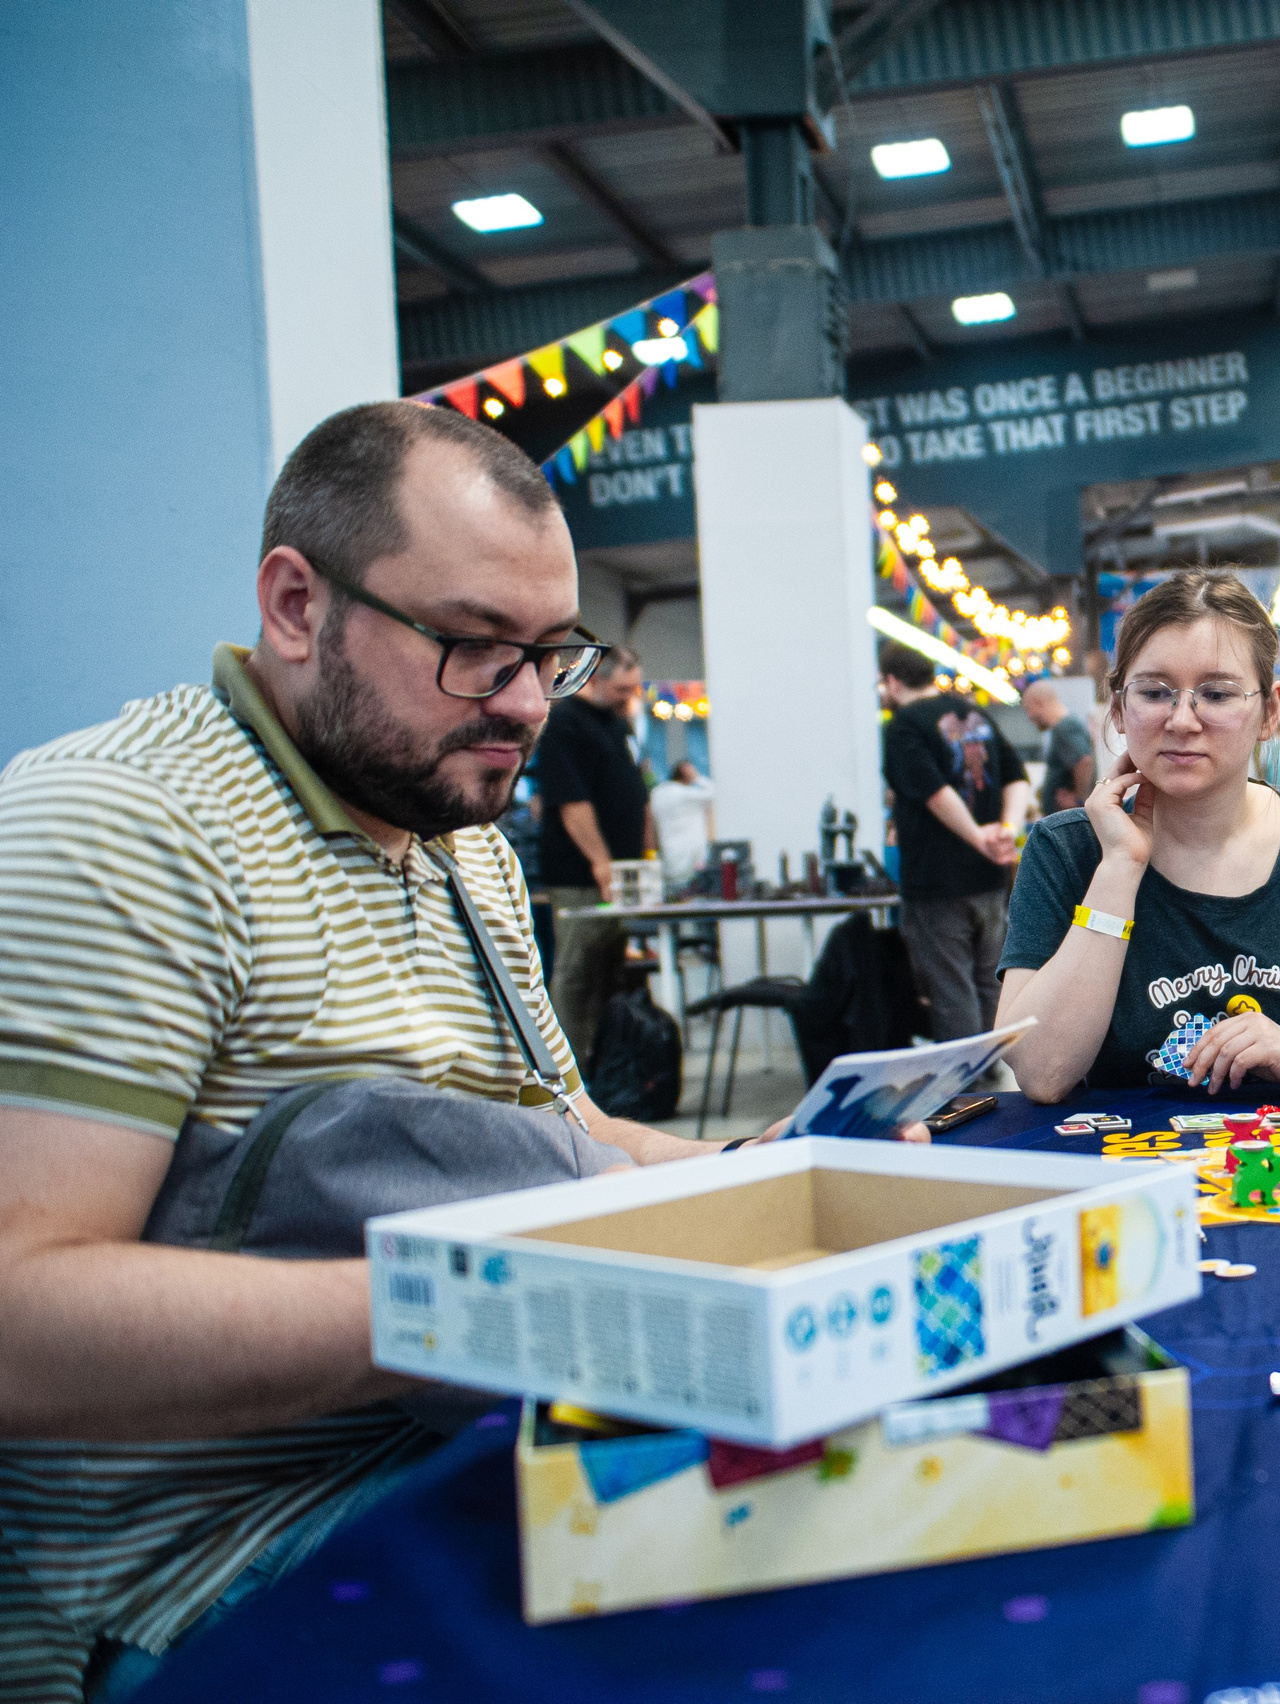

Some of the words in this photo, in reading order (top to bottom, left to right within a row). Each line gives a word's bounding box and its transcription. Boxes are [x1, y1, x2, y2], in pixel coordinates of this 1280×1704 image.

[588, 429, 668, 467] VEN
[897, 386, 970, 426] WAS
[974, 375, 1059, 418] ONCE
[1063, 371, 1091, 406] A
[1093, 351, 1248, 402] BEGINNER
[588, 464, 683, 506] DON'T
[905, 423, 986, 465] TAKE
[988, 412, 1067, 454] THAT
[1074, 401, 1161, 446] FIRST
[1170, 390, 1248, 432] STEP
[1149, 963, 1232, 1009] Merry
